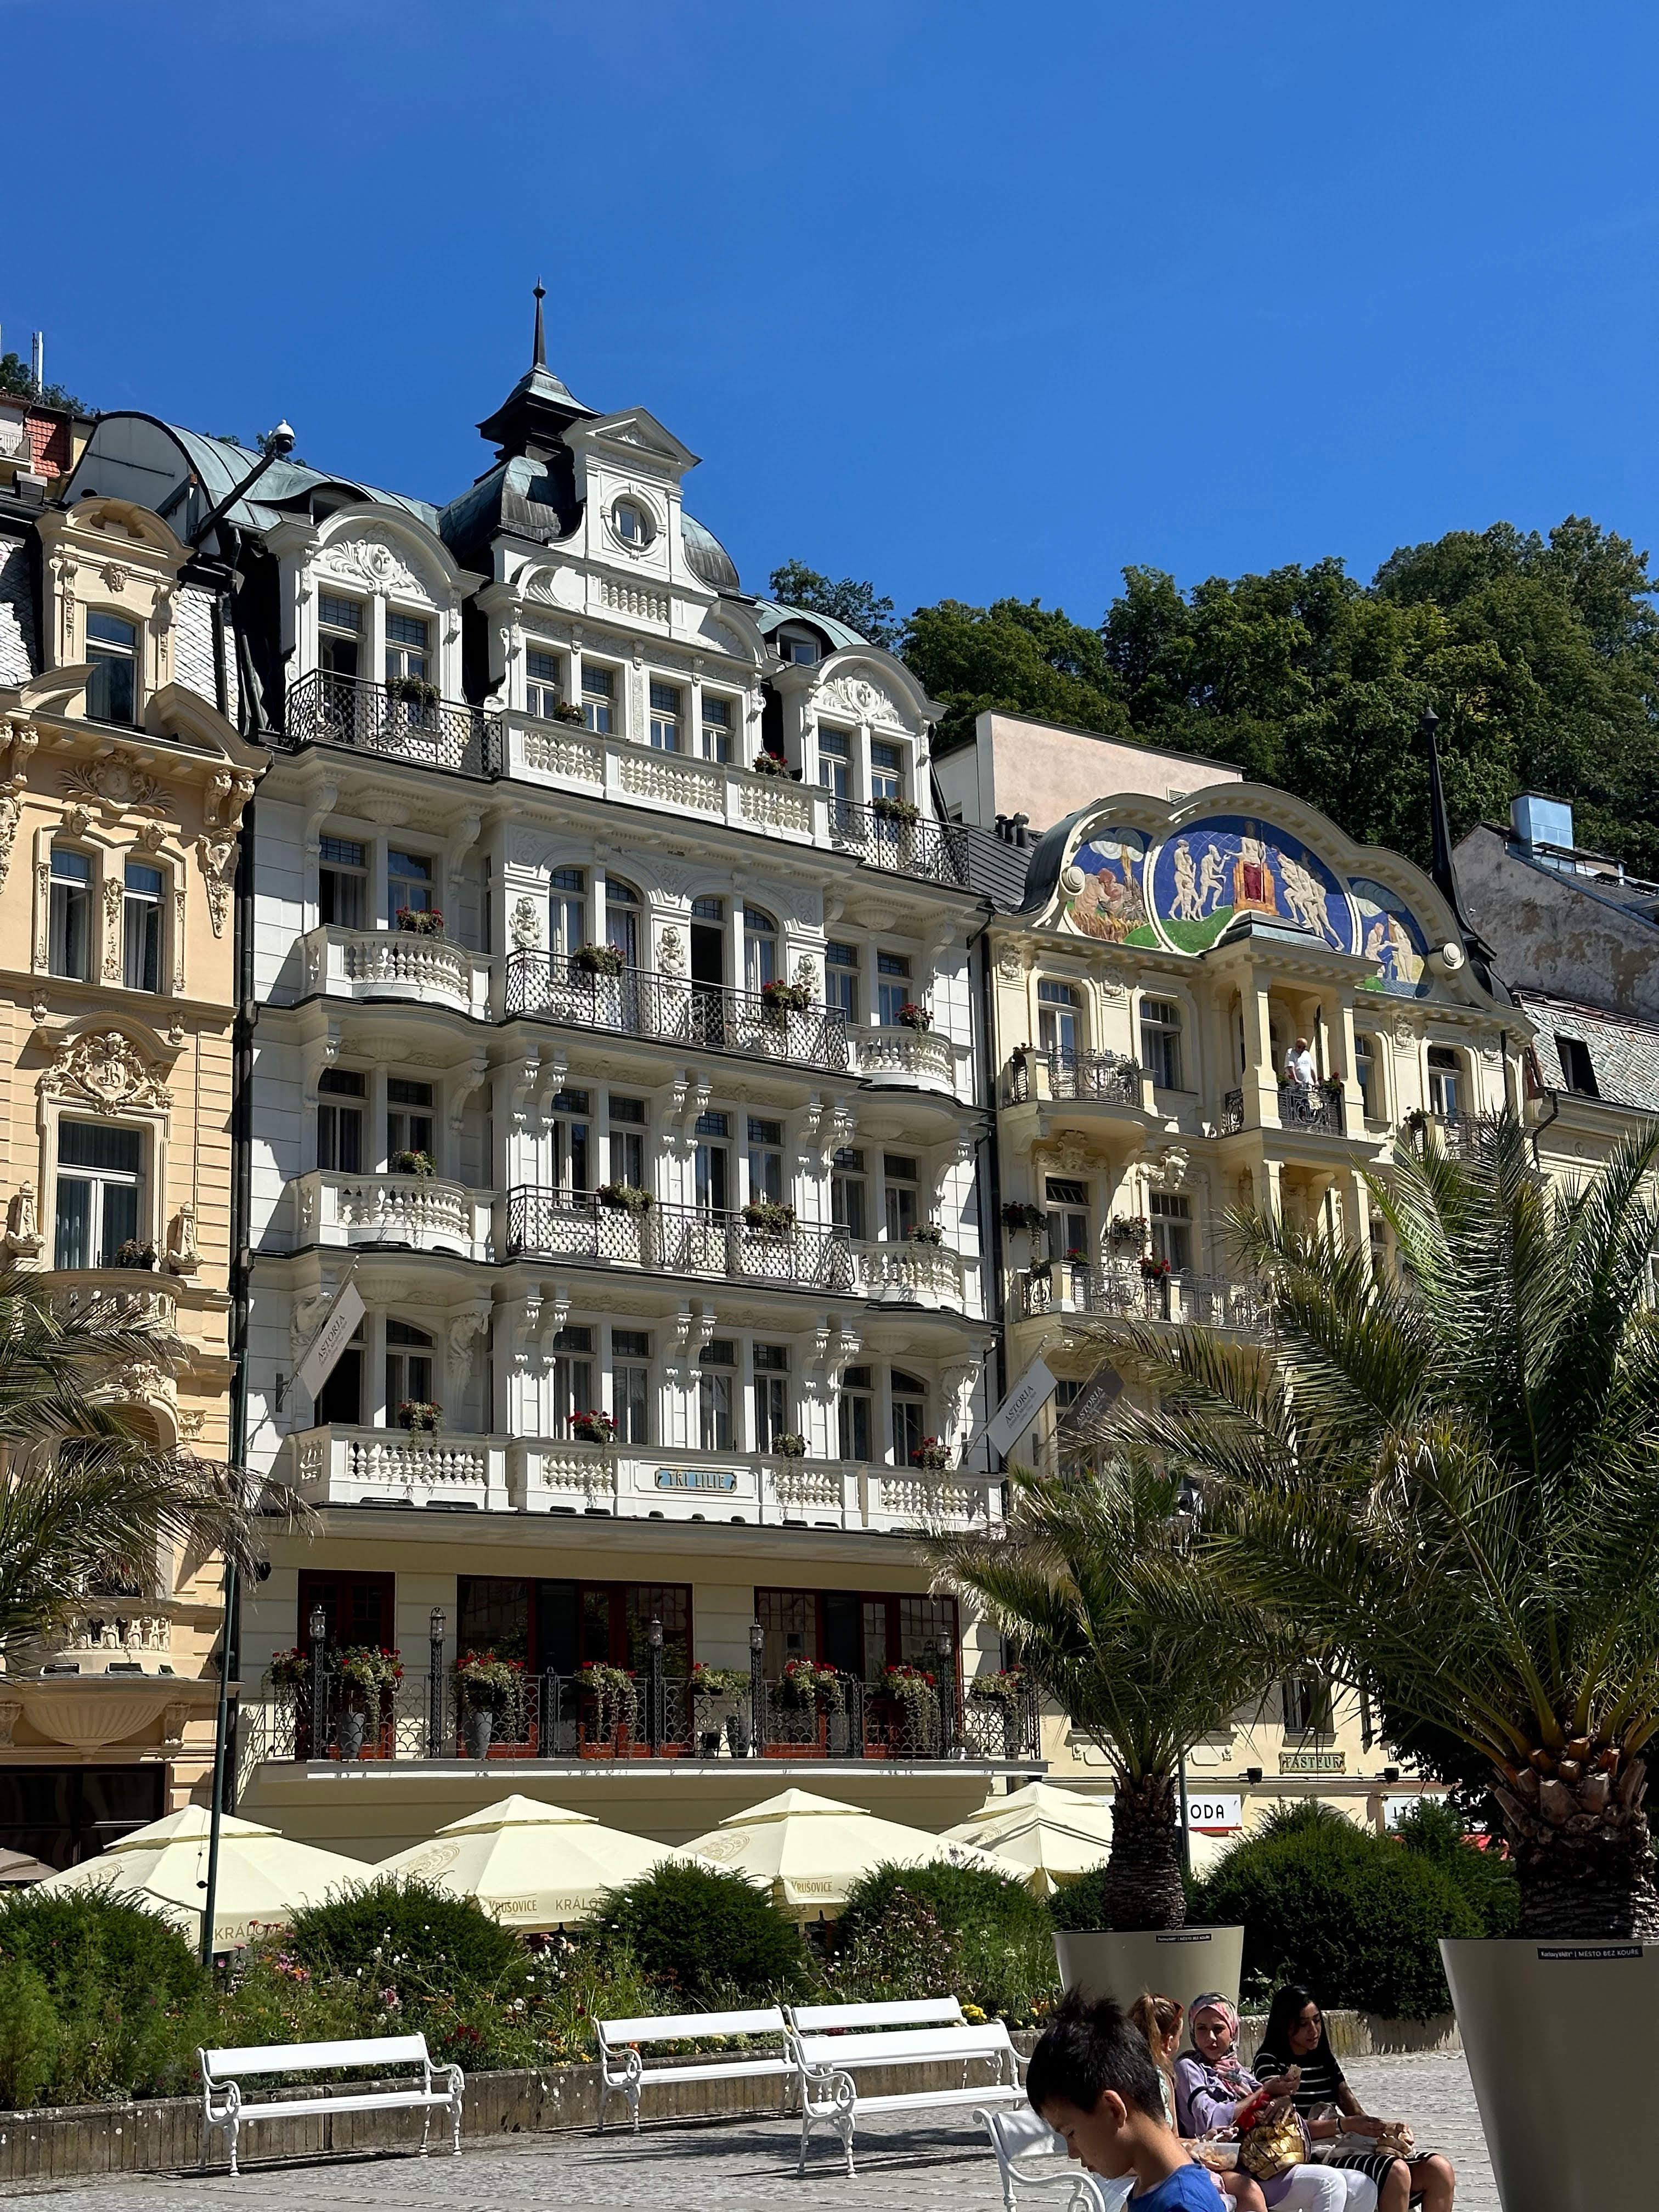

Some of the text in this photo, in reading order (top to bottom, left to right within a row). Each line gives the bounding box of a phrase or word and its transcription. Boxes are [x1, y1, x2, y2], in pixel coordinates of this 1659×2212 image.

[318, 1314, 345, 1362] ASTORIA
[1005, 1385, 1034, 1424] ASTORIA
[1076, 1386, 1104, 1426] ASTORIA
[668, 1470, 725, 1488] TRI LILIE
[1285, 1756, 1340, 1768] PASTEUR
[1176, 1804, 1224, 1819] ODA
[555, 1895, 599, 1911] KRÁLO
